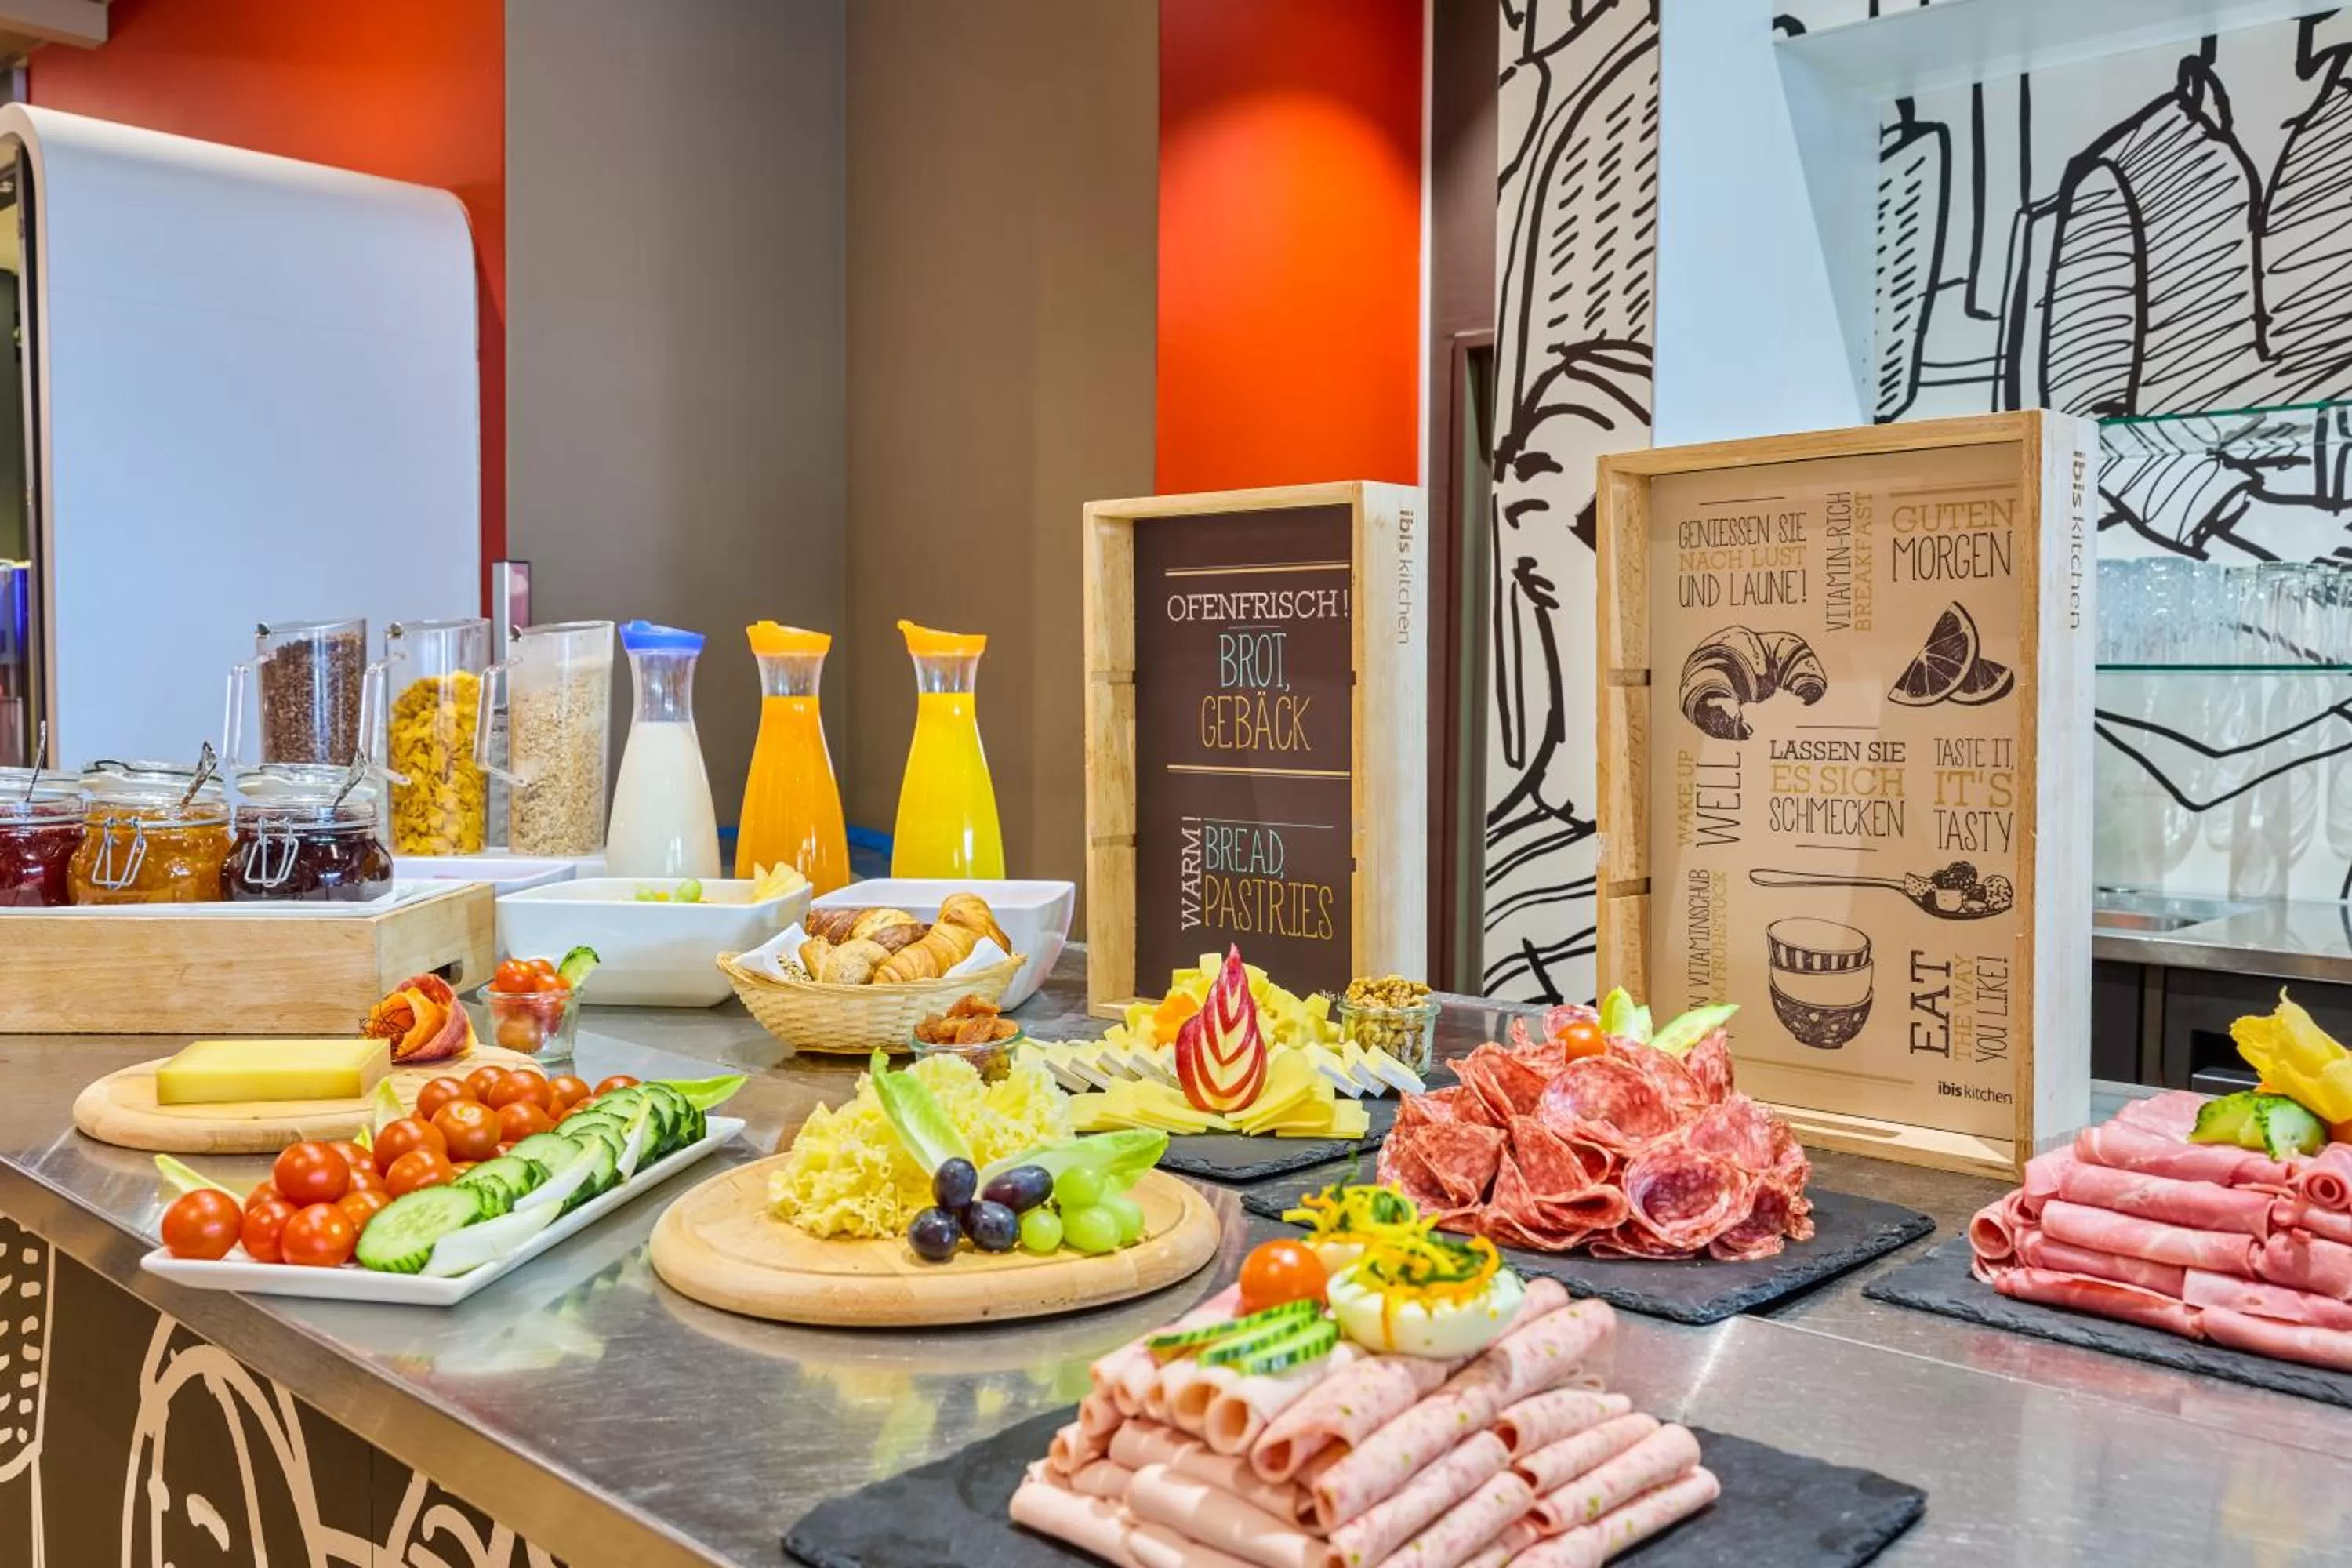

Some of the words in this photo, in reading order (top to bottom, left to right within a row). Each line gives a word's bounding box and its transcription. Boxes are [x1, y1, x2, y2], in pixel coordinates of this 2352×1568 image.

[2071, 450, 2086, 509] ibis
[1397, 509, 1414, 554] ibis
[1679, 514, 1771, 549] GENIESSEN
[1778, 512, 1807, 543] SIE
[1891, 499, 2017, 534] GUTEN
[1679, 547, 1744, 571] NACH
[1751, 545, 1808, 568] LUST
[1826, 491, 1852, 631] VITAMIN-RICH
[1854, 491, 1874, 632] BREAKFAST
[1892, 532, 2013, 583] MORGEN
[2069, 518, 2082, 630] kitchen
[1167, 589, 1348, 622] OFENFRISCH!
[1396, 558, 1413, 645] kitchen
[1679, 573, 1721, 608] UND
[1730, 569, 1807, 607] LAUNE!
[1219, 633, 1290, 691] BROT,
[1201, 691, 1312, 751] GEBÄCK
[1676, 750, 1695, 777] UP
[1769, 740, 1859, 762] LASSEN
[1868, 741, 1906, 763] SIE
[1933, 738, 1987, 769] TASTE
[1992, 738, 2015, 771] IT,
[1695, 750, 1742, 849] WELL
[1770, 764, 1811, 794] ES
[1820, 765, 1905, 797] SICH
[1933, 771, 2013, 808] IT'S
[1676, 782, 1694, 848] WAKE
[1769, 796, 1905, 839] SCHMECKEN
[1933, 809, 2013, 853] TASTY
[1181, 816, 1203, 932] WARM!
[1204, 826, 1285, 879] BREAD,
[1204, 874, 1334, 940] PASTRIES
[1687, 868, 1711, 988] VITAMINSCHUB
[1909, 949, 1952, 1059] EAT
[1954, 953, 1973, 1008] WAY
[1975, 956, 2008, 1017] LIKE!
[1953, 1015, 1972, 1062] THE
[1975, 1024, 2008, 1064] YOU
[1938, 1081, 1962, 1098] ibis
[1964, 1083, 2013, 1105] kitchen
